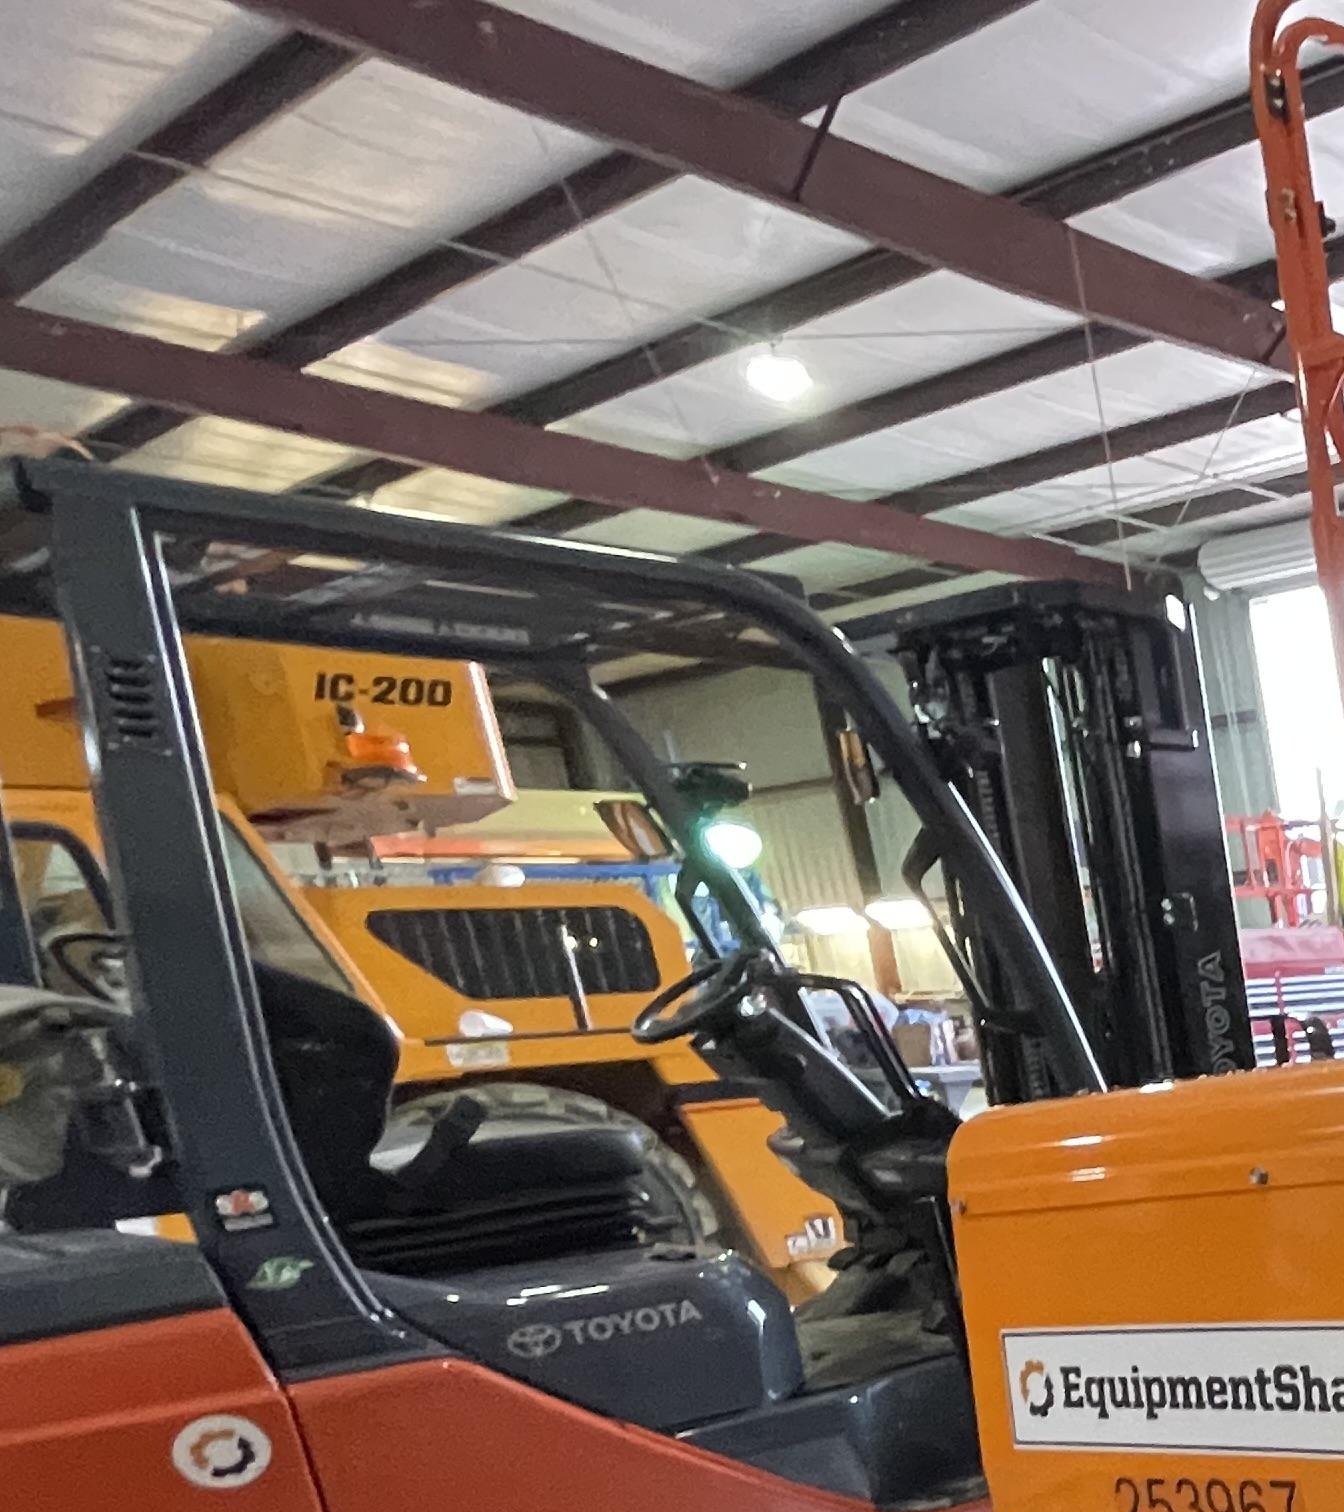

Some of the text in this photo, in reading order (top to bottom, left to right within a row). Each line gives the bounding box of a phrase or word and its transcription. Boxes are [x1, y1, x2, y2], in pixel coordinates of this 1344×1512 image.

[314, 671, 453, 707] IC-200
[1197, 950, 1237, 1077] OYOTA
[562, 1299, 703, 1345] TOYOTA
